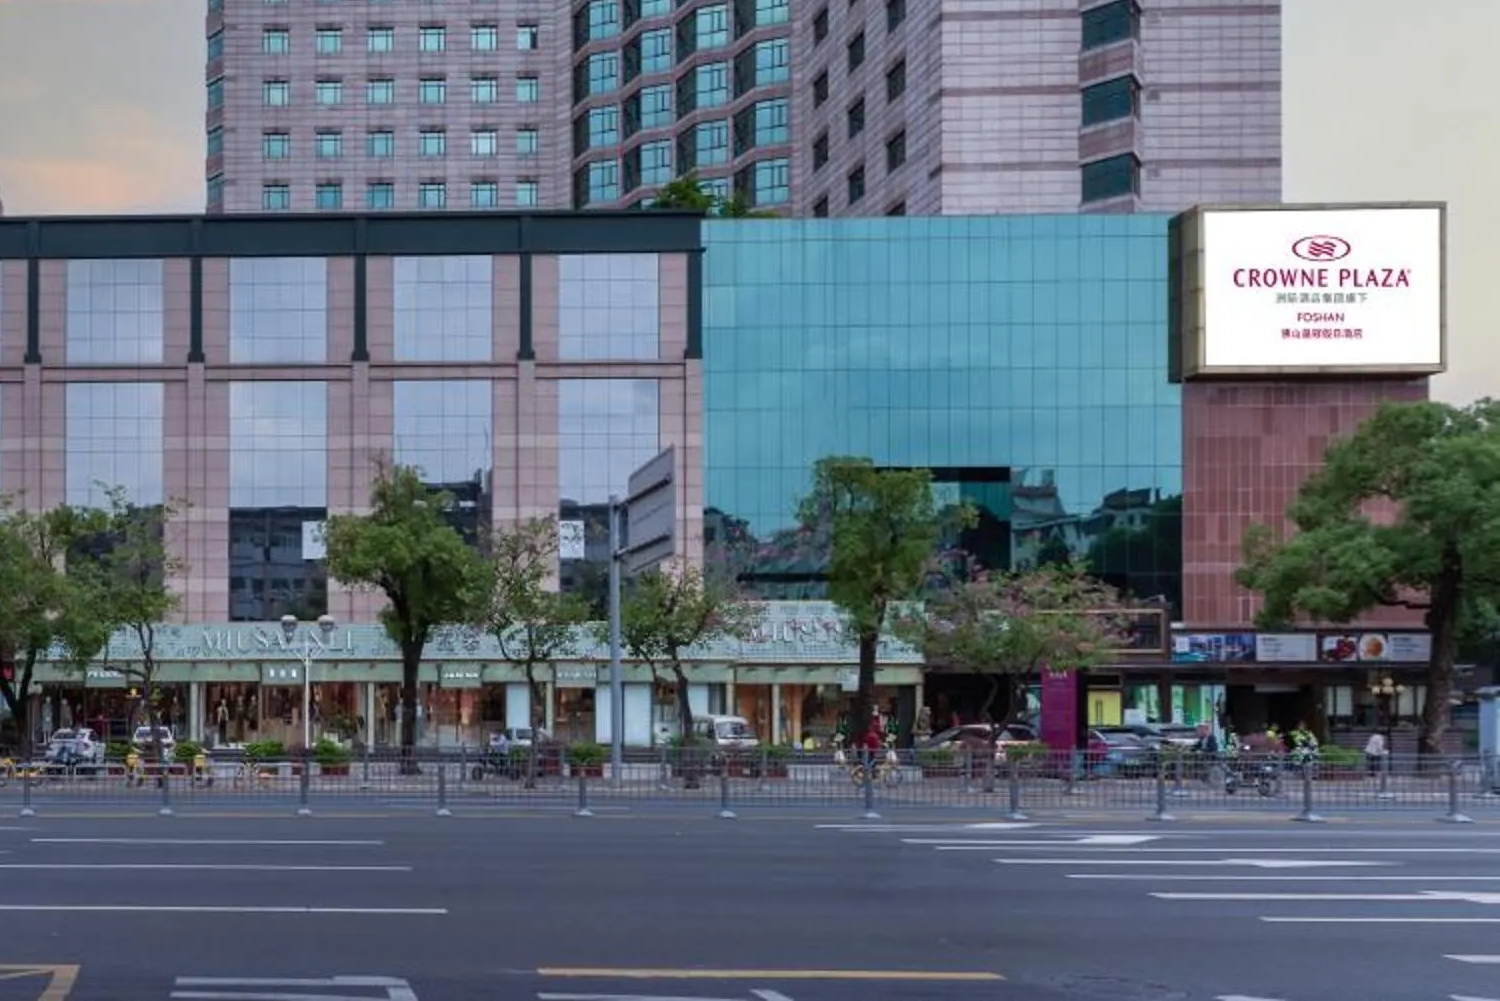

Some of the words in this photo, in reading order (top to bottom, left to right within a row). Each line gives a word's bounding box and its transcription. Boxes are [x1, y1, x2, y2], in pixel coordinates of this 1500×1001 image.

[1233, 268, 1329, 288] CROWNE
[1339, 268, 1410, 288] PLAZA
[1297, 312, 1345, 322] FOSHAN
